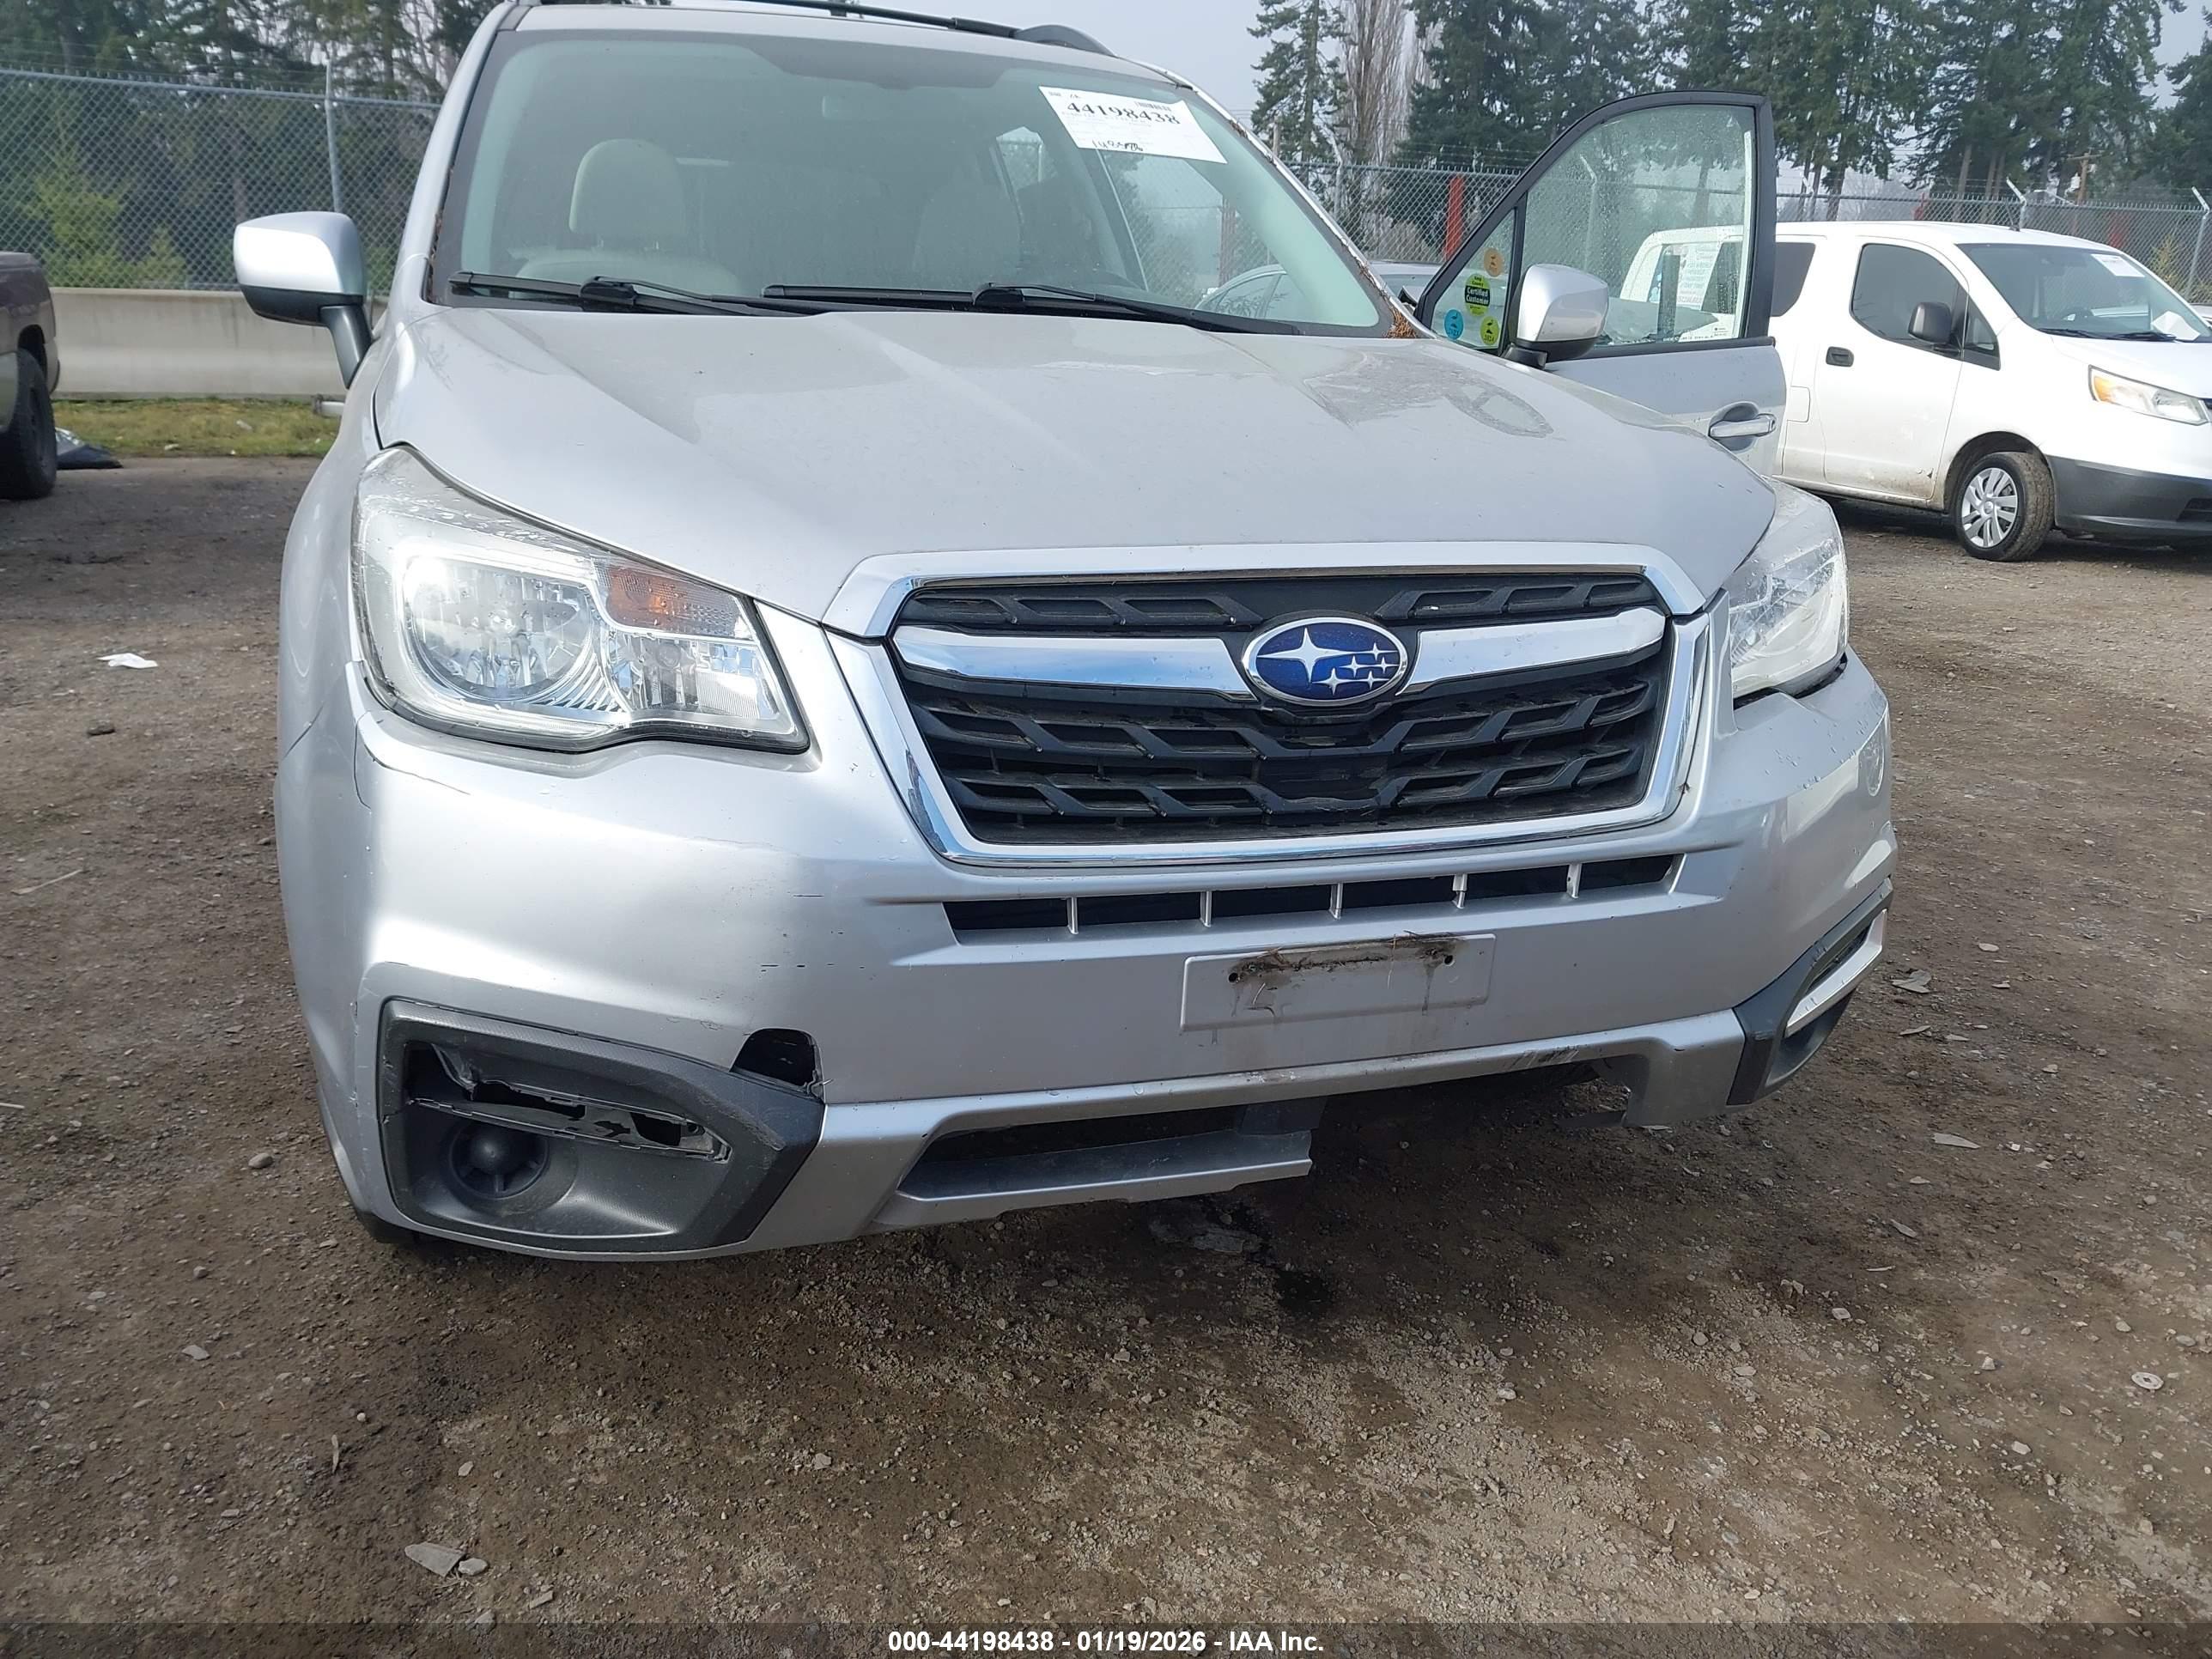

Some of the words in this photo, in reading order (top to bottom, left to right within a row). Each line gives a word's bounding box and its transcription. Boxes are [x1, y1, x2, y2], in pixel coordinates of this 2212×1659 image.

[1067, 102, 1181, 125] 44198438
[1468, 287, 1488, 296] Certified
[1467, 295, 1489, 304] Customer
